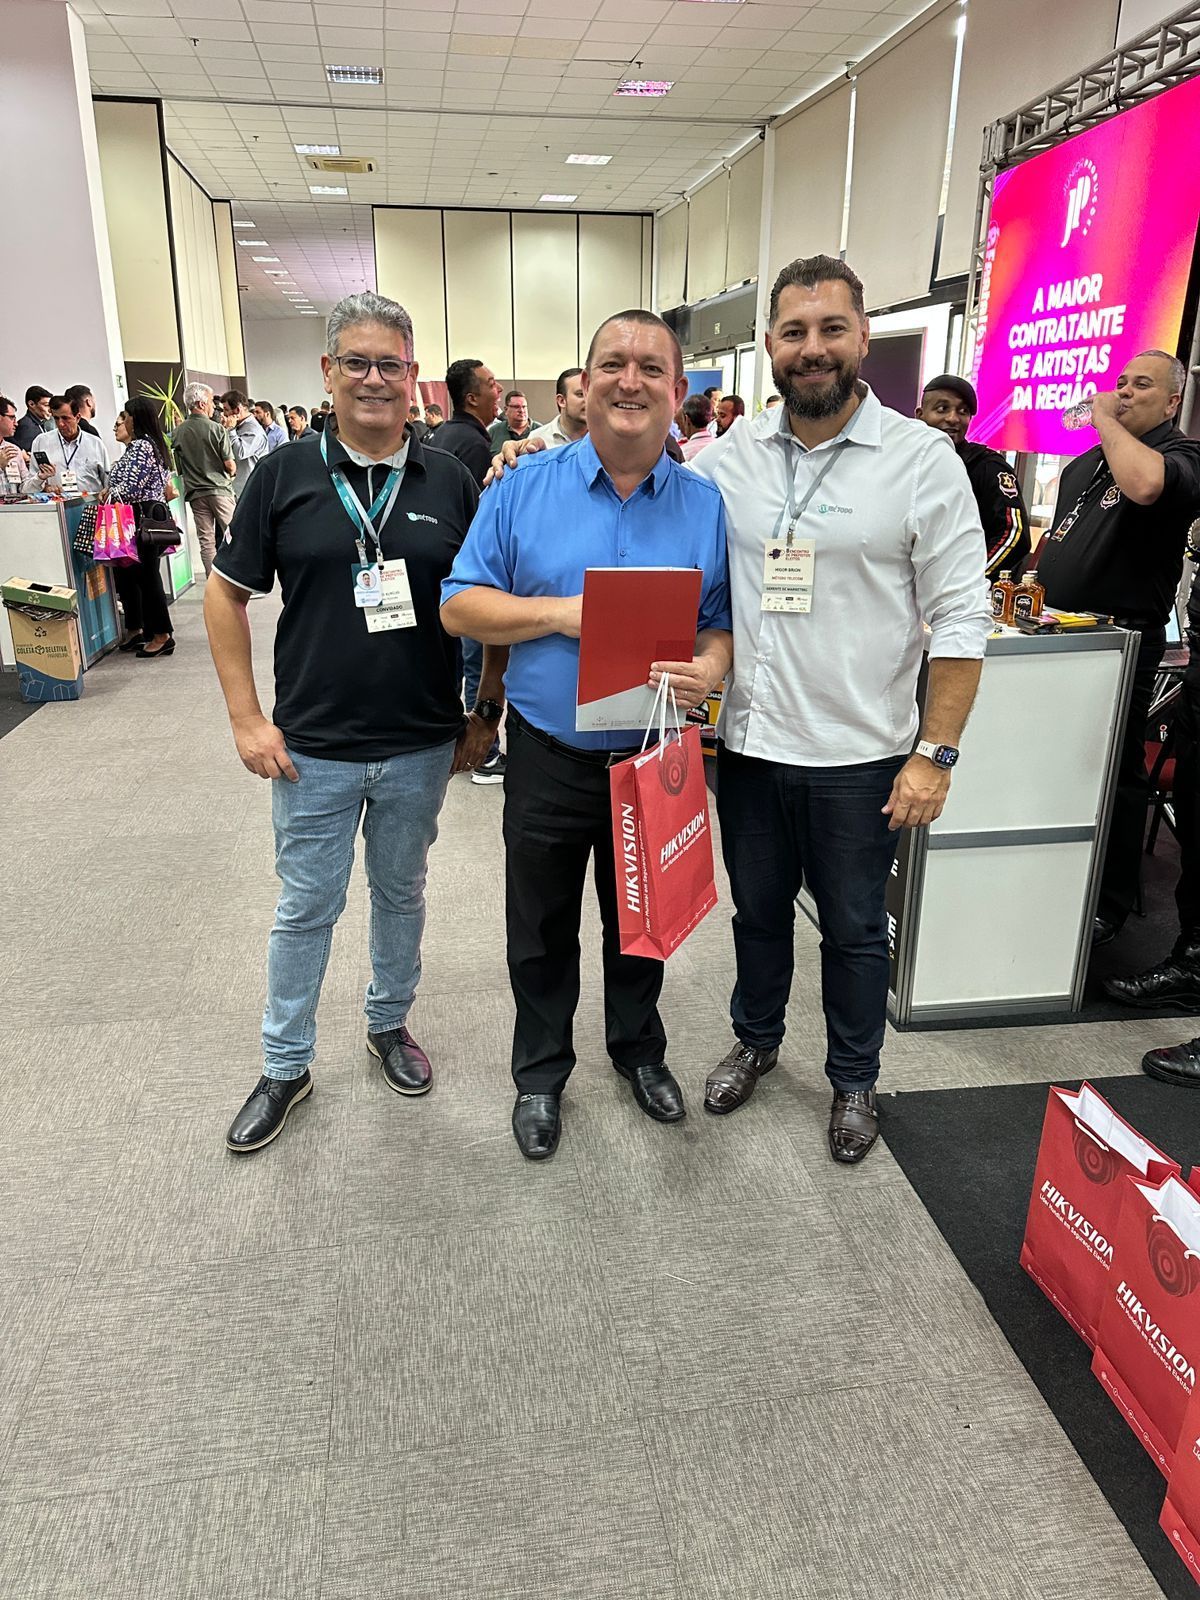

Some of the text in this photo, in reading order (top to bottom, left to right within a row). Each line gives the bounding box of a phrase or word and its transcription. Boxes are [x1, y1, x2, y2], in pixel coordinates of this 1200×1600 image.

[1031, 273, 1103, 315] A MAIOR
[1008, 304, 1127, 349] CONTRATANTE
[1010, 344, 1112, 380] DE ARTISTAS
[1012, 384, 1033, 411] DA
[376, 604, 404, 613] CONVIDADO
[16, 645, 67, 655] COLETA SELETIVA
[660, 809, 705, 864] HIKVISION
[621, 803, 641, 913] HIKVISION
